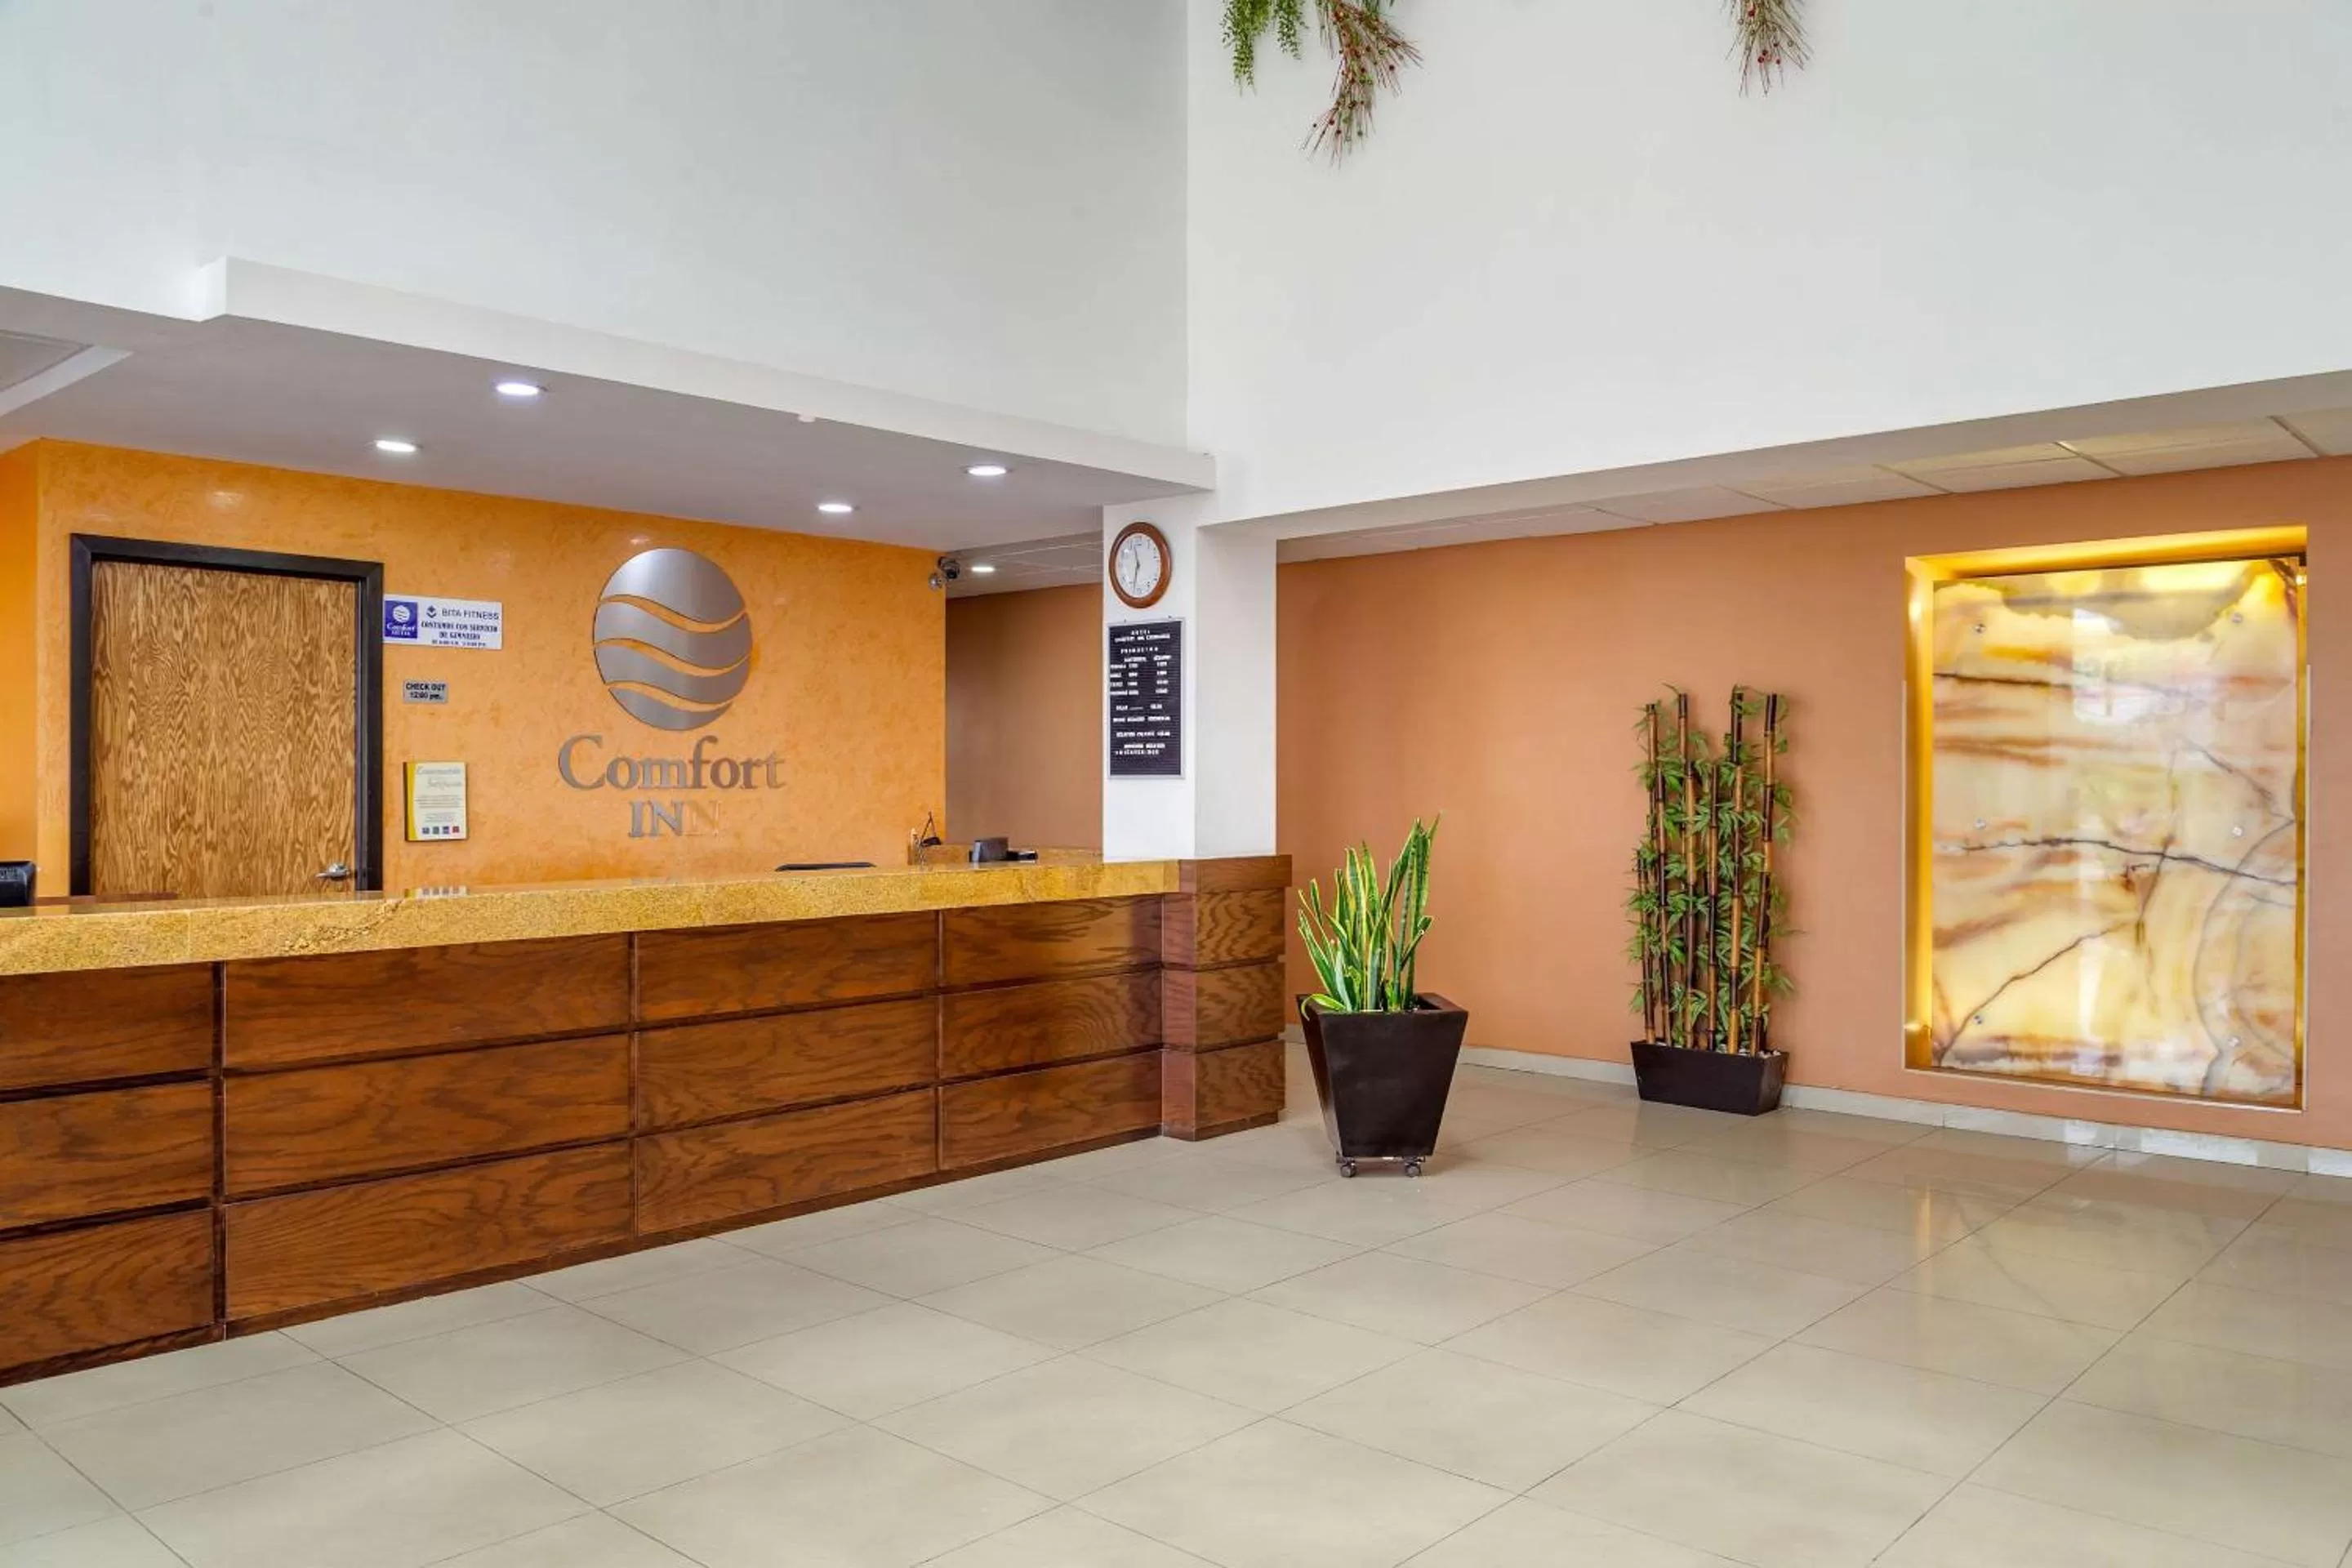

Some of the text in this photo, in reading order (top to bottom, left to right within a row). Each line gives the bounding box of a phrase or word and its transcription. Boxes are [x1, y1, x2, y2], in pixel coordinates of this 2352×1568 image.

[464, 609, 499, 620] FITNESS
[386, 622, 415, 631] Comfort
[406, 683, 446, 691] CHECK OUT
[558, 734, 786, 790] Comfort
[628, 800, 721, 838] INN
